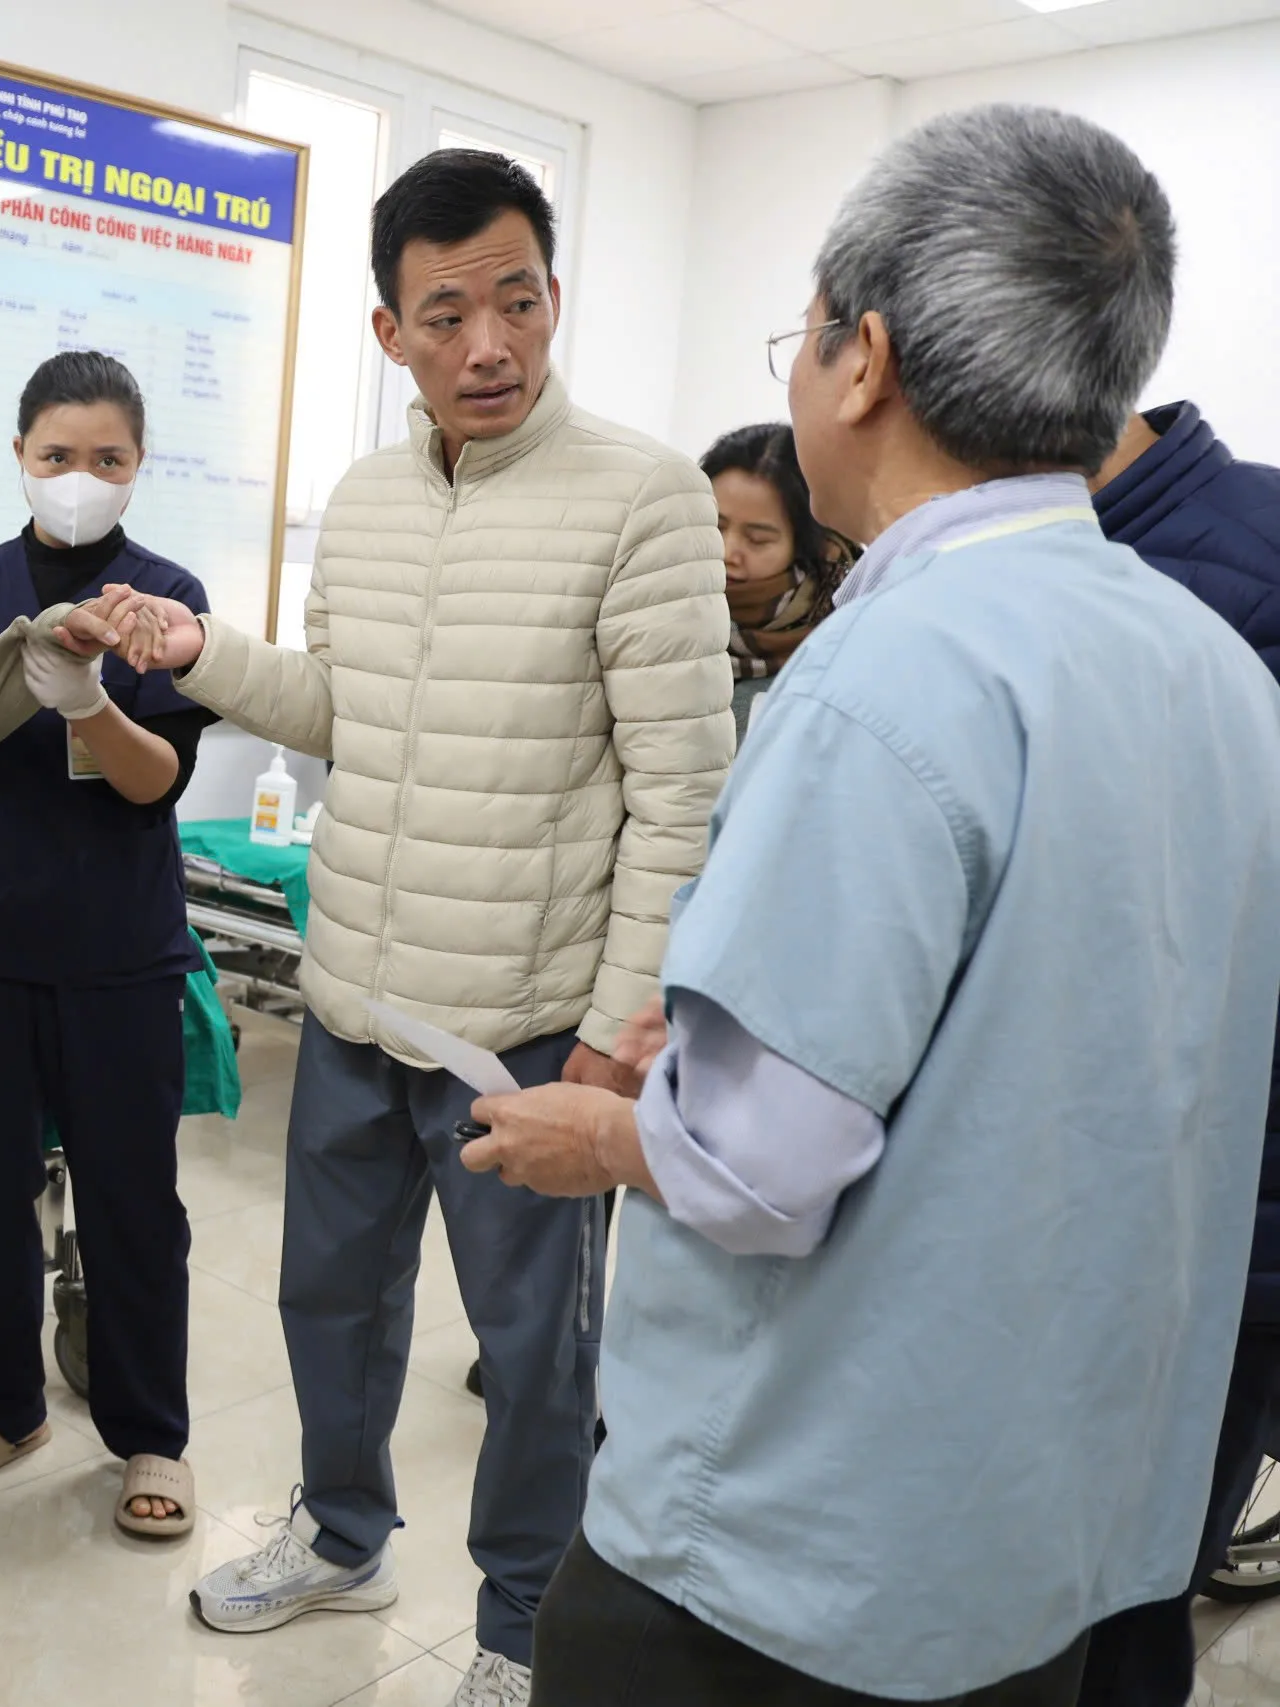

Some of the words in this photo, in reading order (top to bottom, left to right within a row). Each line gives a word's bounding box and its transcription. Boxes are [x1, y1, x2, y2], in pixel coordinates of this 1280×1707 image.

[40, 149, 95, 195] TRỊ
[104, 165, 204, 217] NGOẠI
[214, 191, 272, 230] TRÚ
[49, 205, 91, 232] CÔNG
[96, 216, 137, 242] CÔNG
[141, 225, 172, 251] VIỆC
